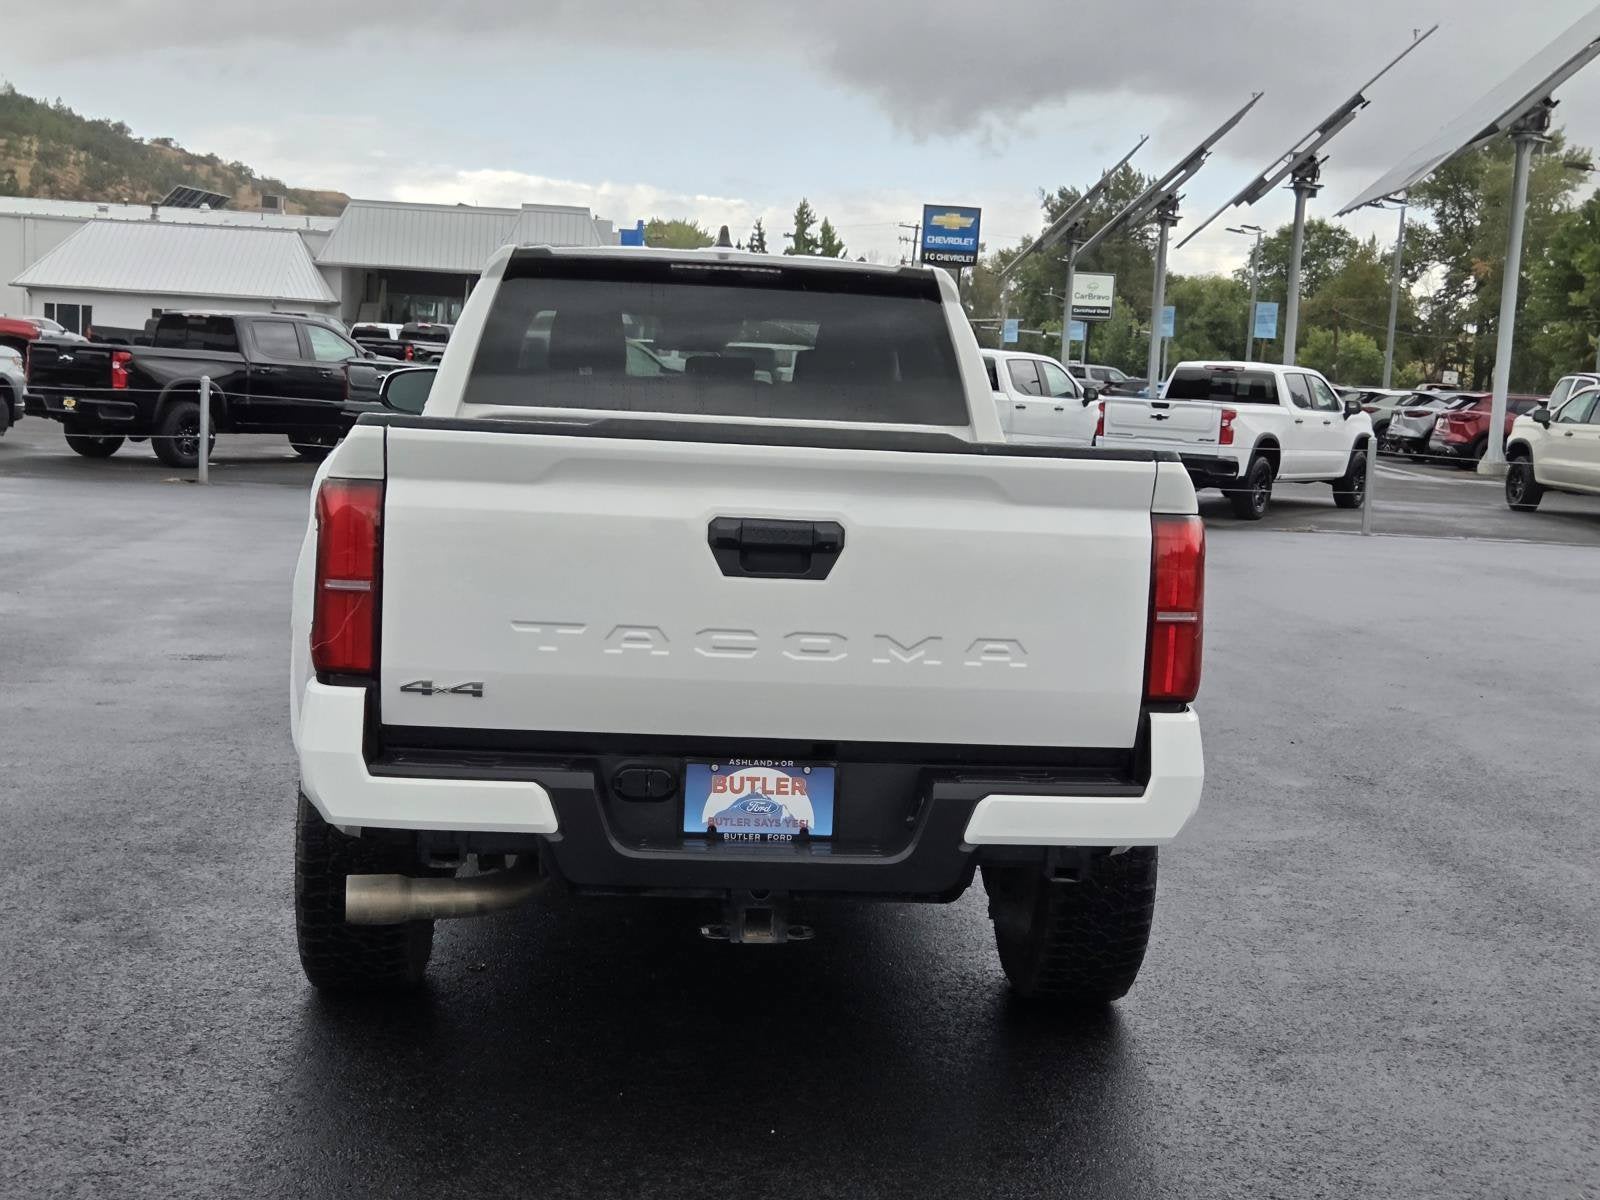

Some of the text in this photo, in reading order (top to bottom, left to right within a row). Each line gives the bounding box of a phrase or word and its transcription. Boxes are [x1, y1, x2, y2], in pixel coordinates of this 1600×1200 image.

[926, 235, 975, 246] CHEVROLET
[936, 254, 975, 263] CHEVROLET
[1074, 292, 1110, 301] CarBravo
[510, 619, 1030, 670] TACOMA
[729, 759, 773, 767] ASHLAND
[712, 775, 807, 796] BUTLER
[746, 800, 772, 813] Ford
[708, 817, 809, 829] BUTLER SAYS YES!
